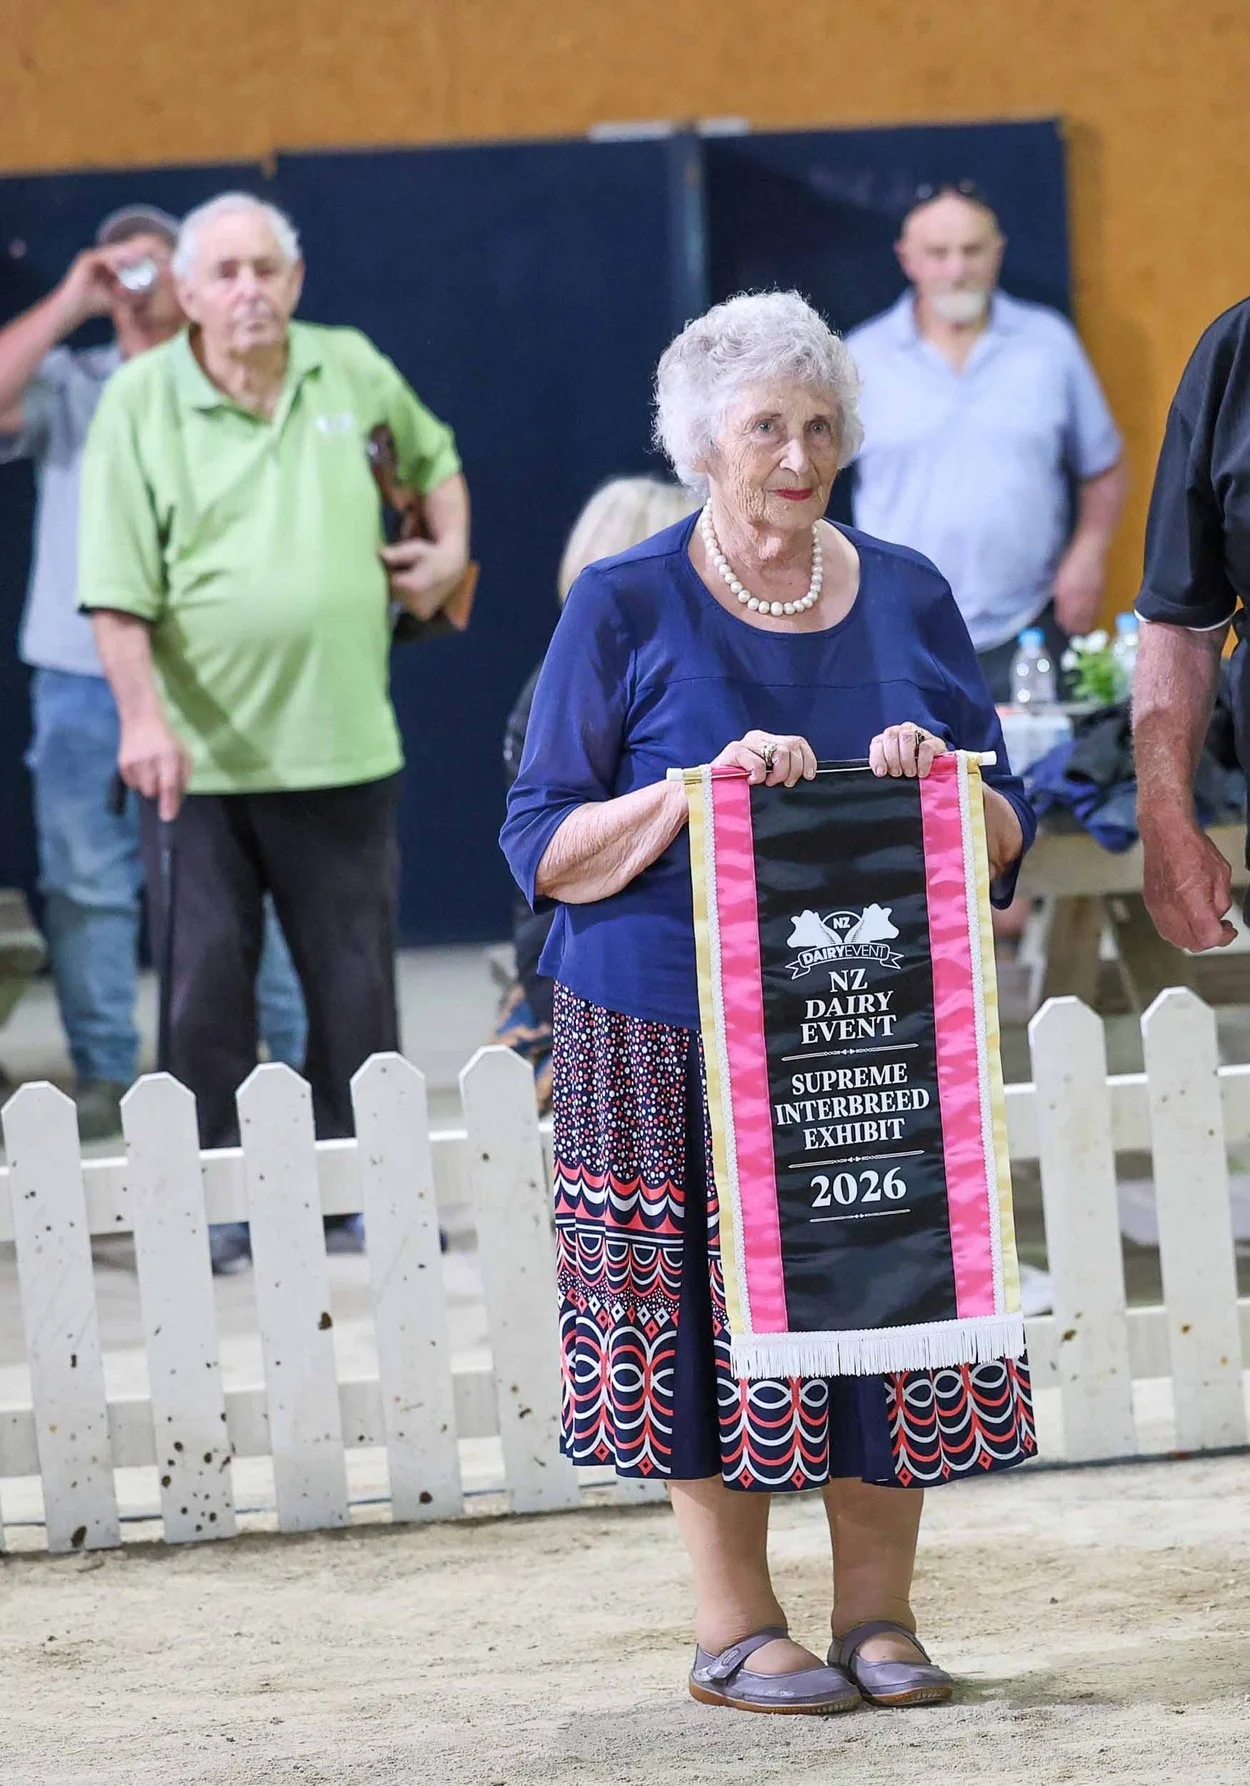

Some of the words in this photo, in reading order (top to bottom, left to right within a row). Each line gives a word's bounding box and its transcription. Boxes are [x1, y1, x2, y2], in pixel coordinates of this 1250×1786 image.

[833, 917, 851, 929] NZ
[802, 945, 886, 965] DAIRYEVENT
[828, 968, 868, 993] NZ
[804, 990, 894, 1020] DAIRY
[800, 1014, 897, 1044] EVENT
[791, 1063, 908, 1096] SUPREME
[774, 1088, 930, 1126] INTERBREED
[803, 1118, 905, 1150] EXHIBIT
[810, 1166, 907, 1208] 2026
